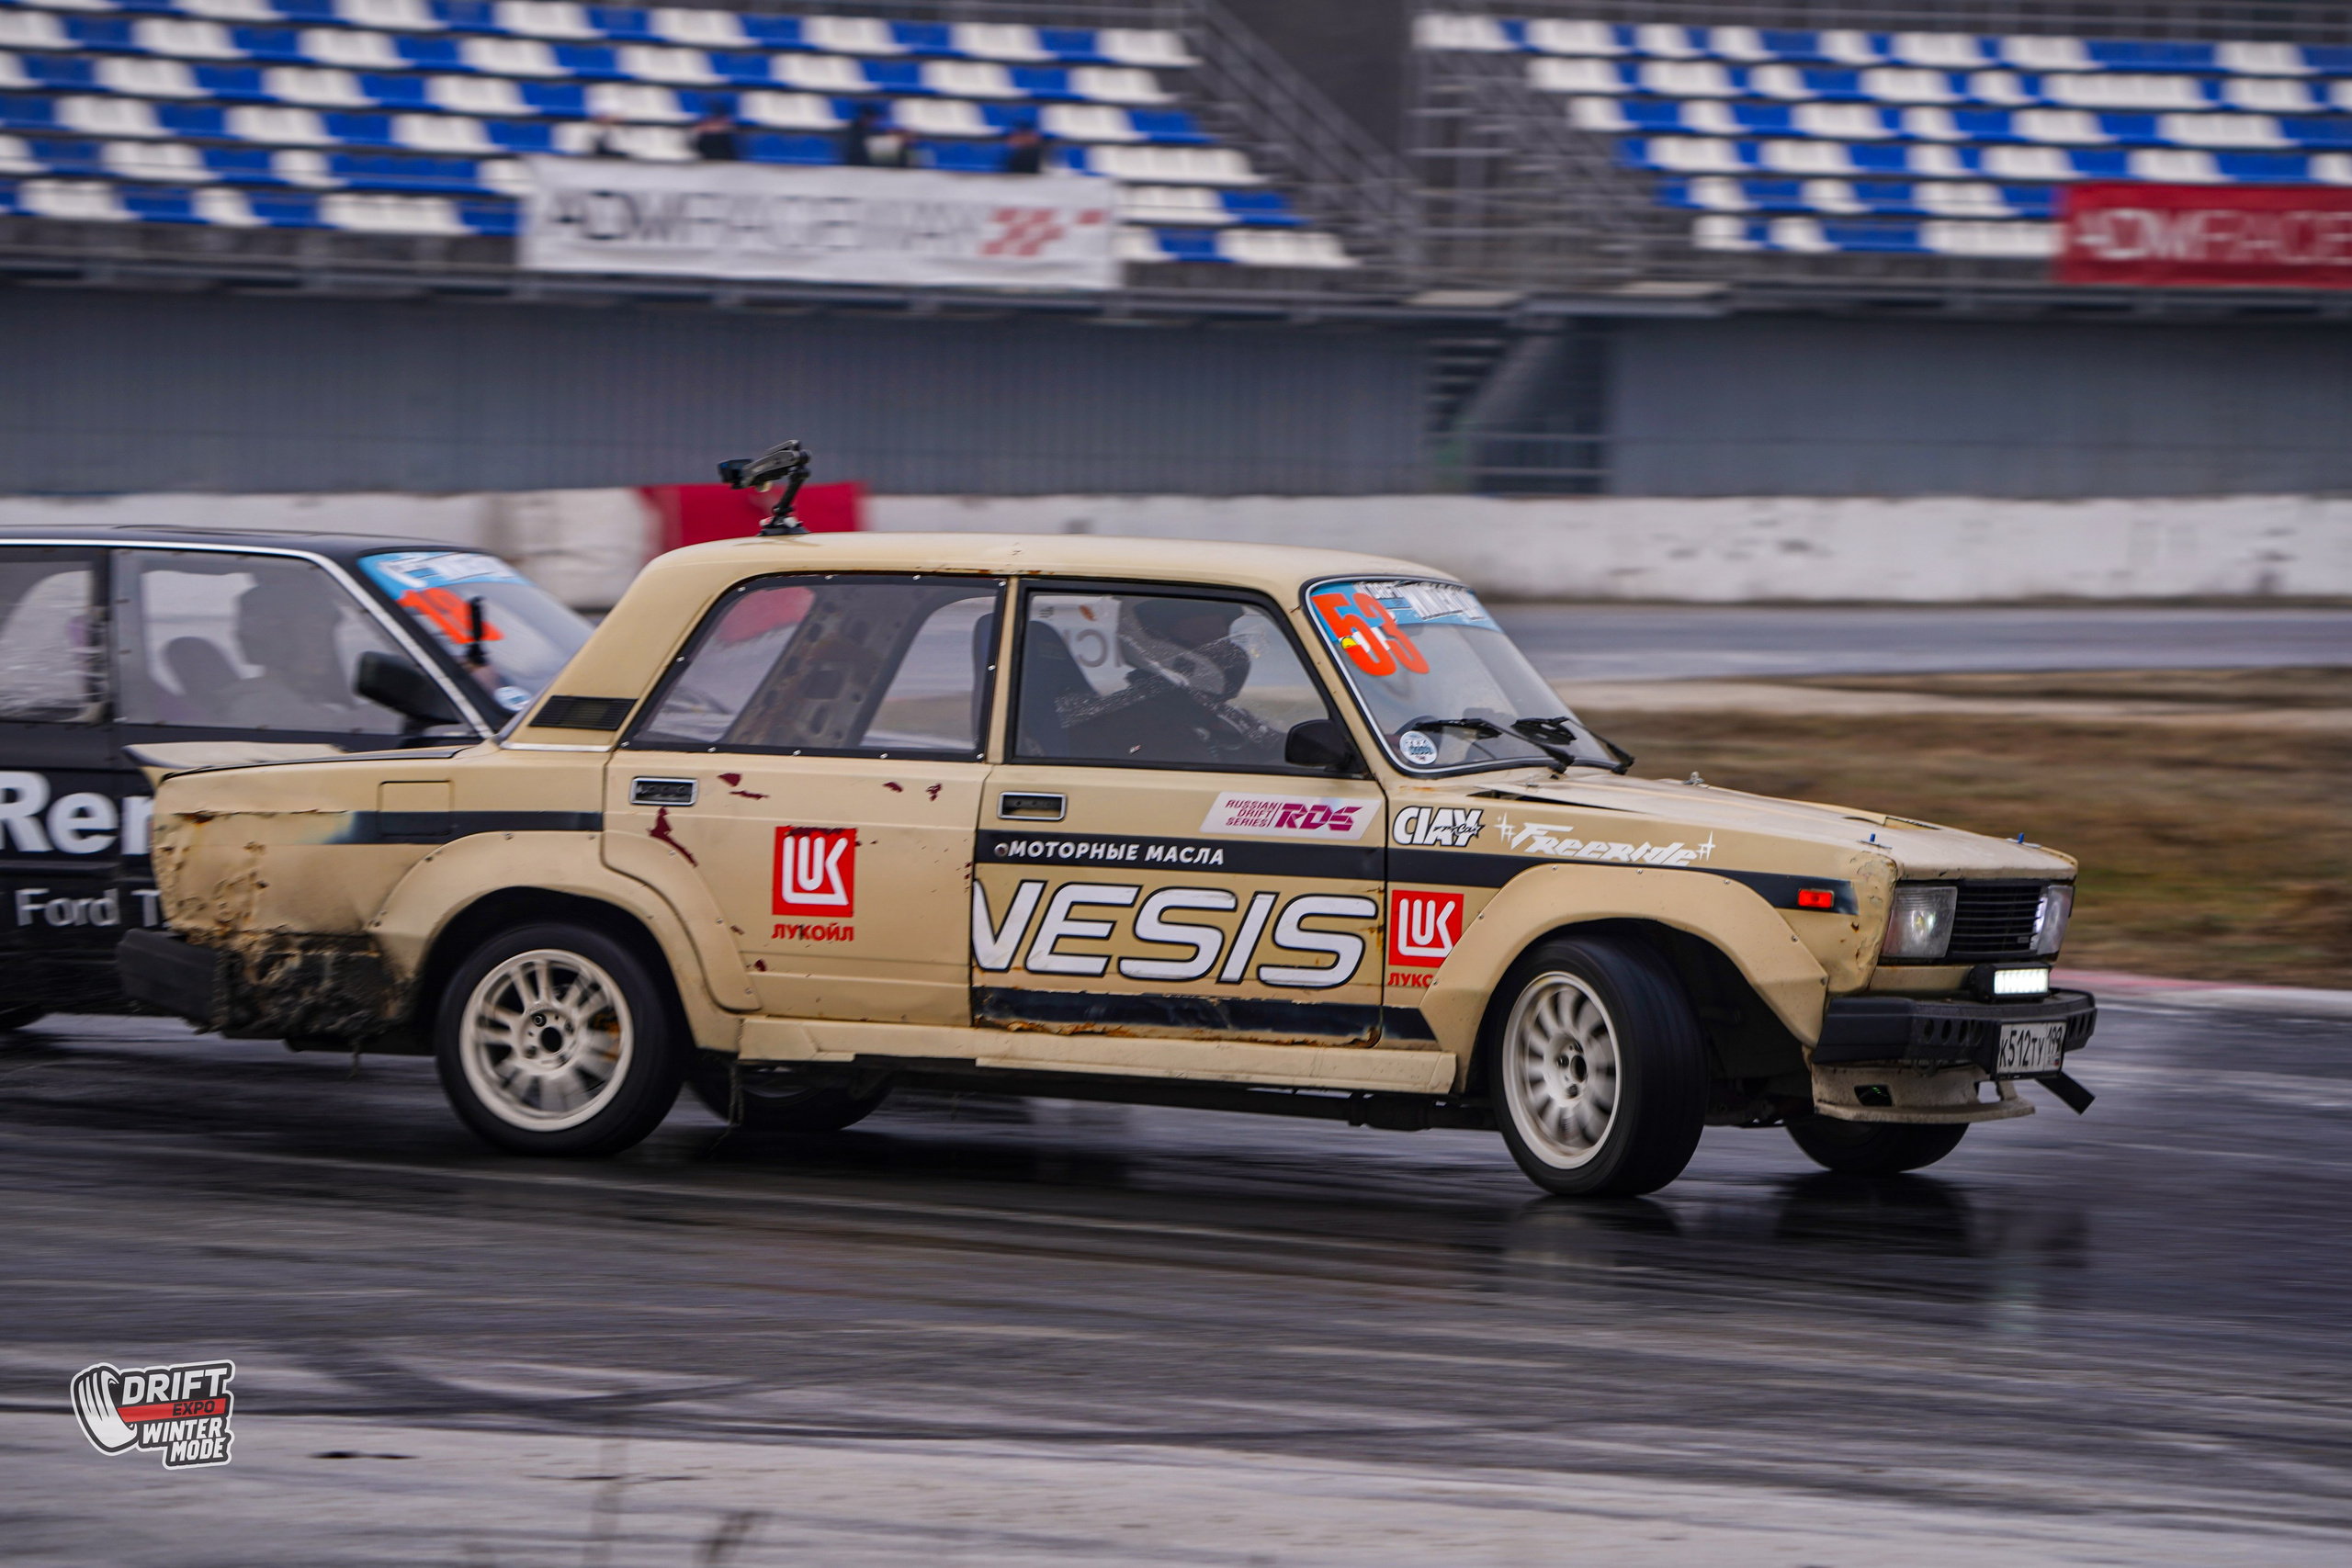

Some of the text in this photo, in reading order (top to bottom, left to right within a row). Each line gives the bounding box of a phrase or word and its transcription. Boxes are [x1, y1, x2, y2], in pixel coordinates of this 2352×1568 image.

[1311, 593, 1430, 676] 53
[1226, 799, 1279, 810] RUSSIAN
[1237, 809, 1272, 818] DRIFT
[1226, 817, 1267, 828] SERIES
[1274, 803, 1363, 831] RDS
[1008, 840, 1225, 865] МОТОРНЫЕ МАСЛА
[15, 888, 172, 928] Ford T
[772, 922, 854, 942] ЛУКОЙЛ
